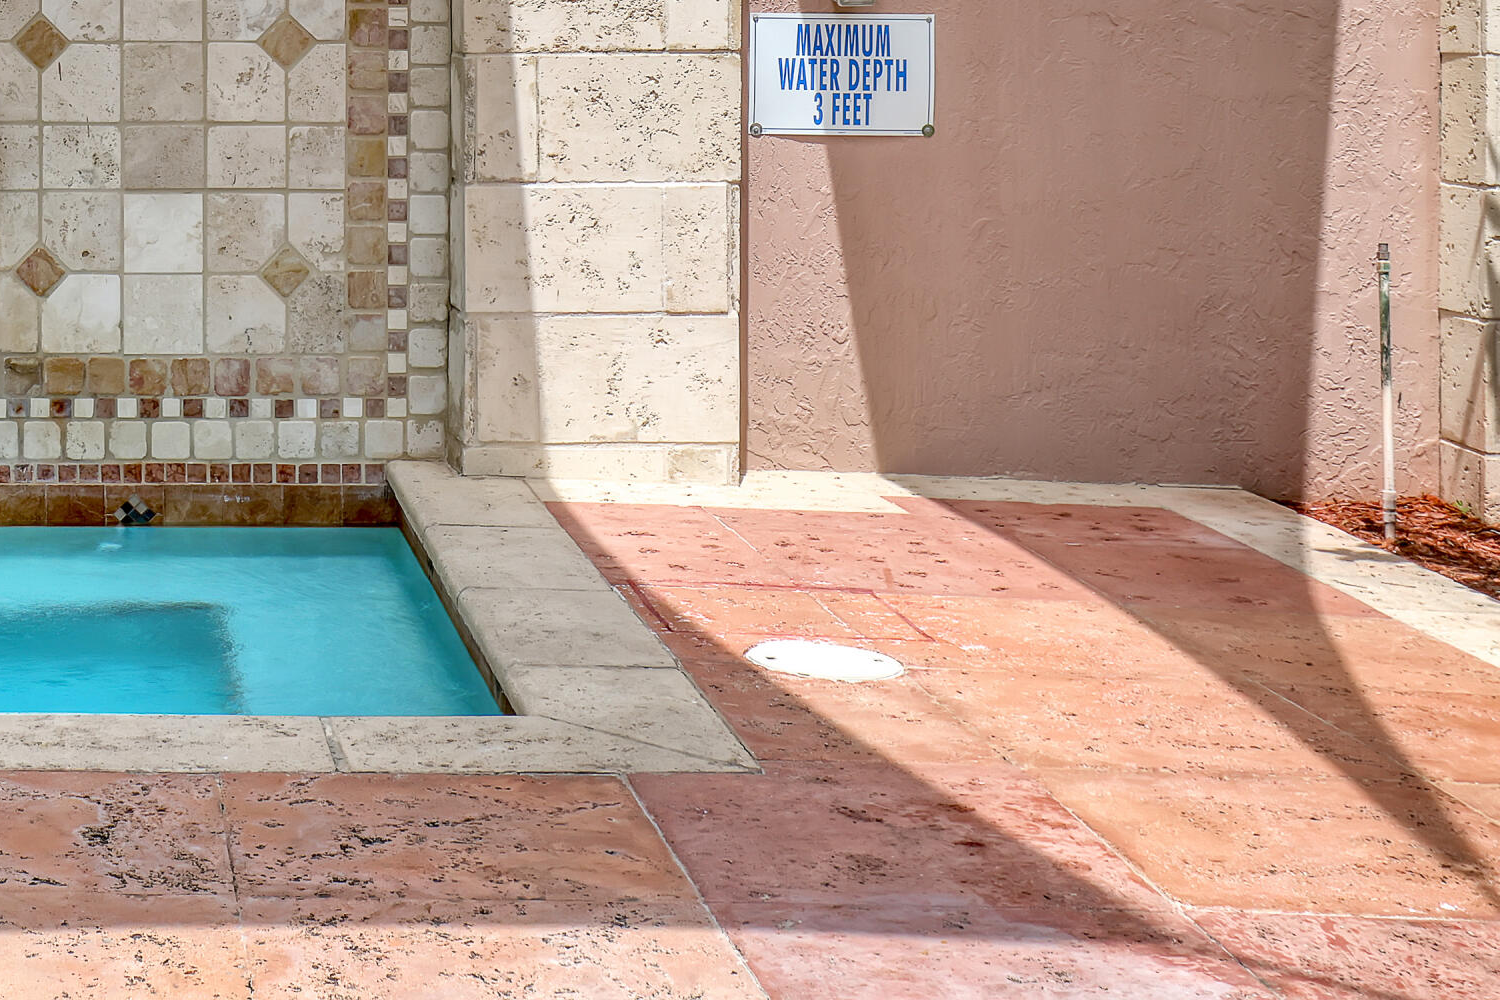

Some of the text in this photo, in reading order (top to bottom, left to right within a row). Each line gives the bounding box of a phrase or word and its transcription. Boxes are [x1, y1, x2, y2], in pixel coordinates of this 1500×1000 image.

[795, 23, 891, 57] MAXIMUM
[778, 57, 908, 92] WATER DEPTH
[813, 92, 873, 126] 3 FEET
